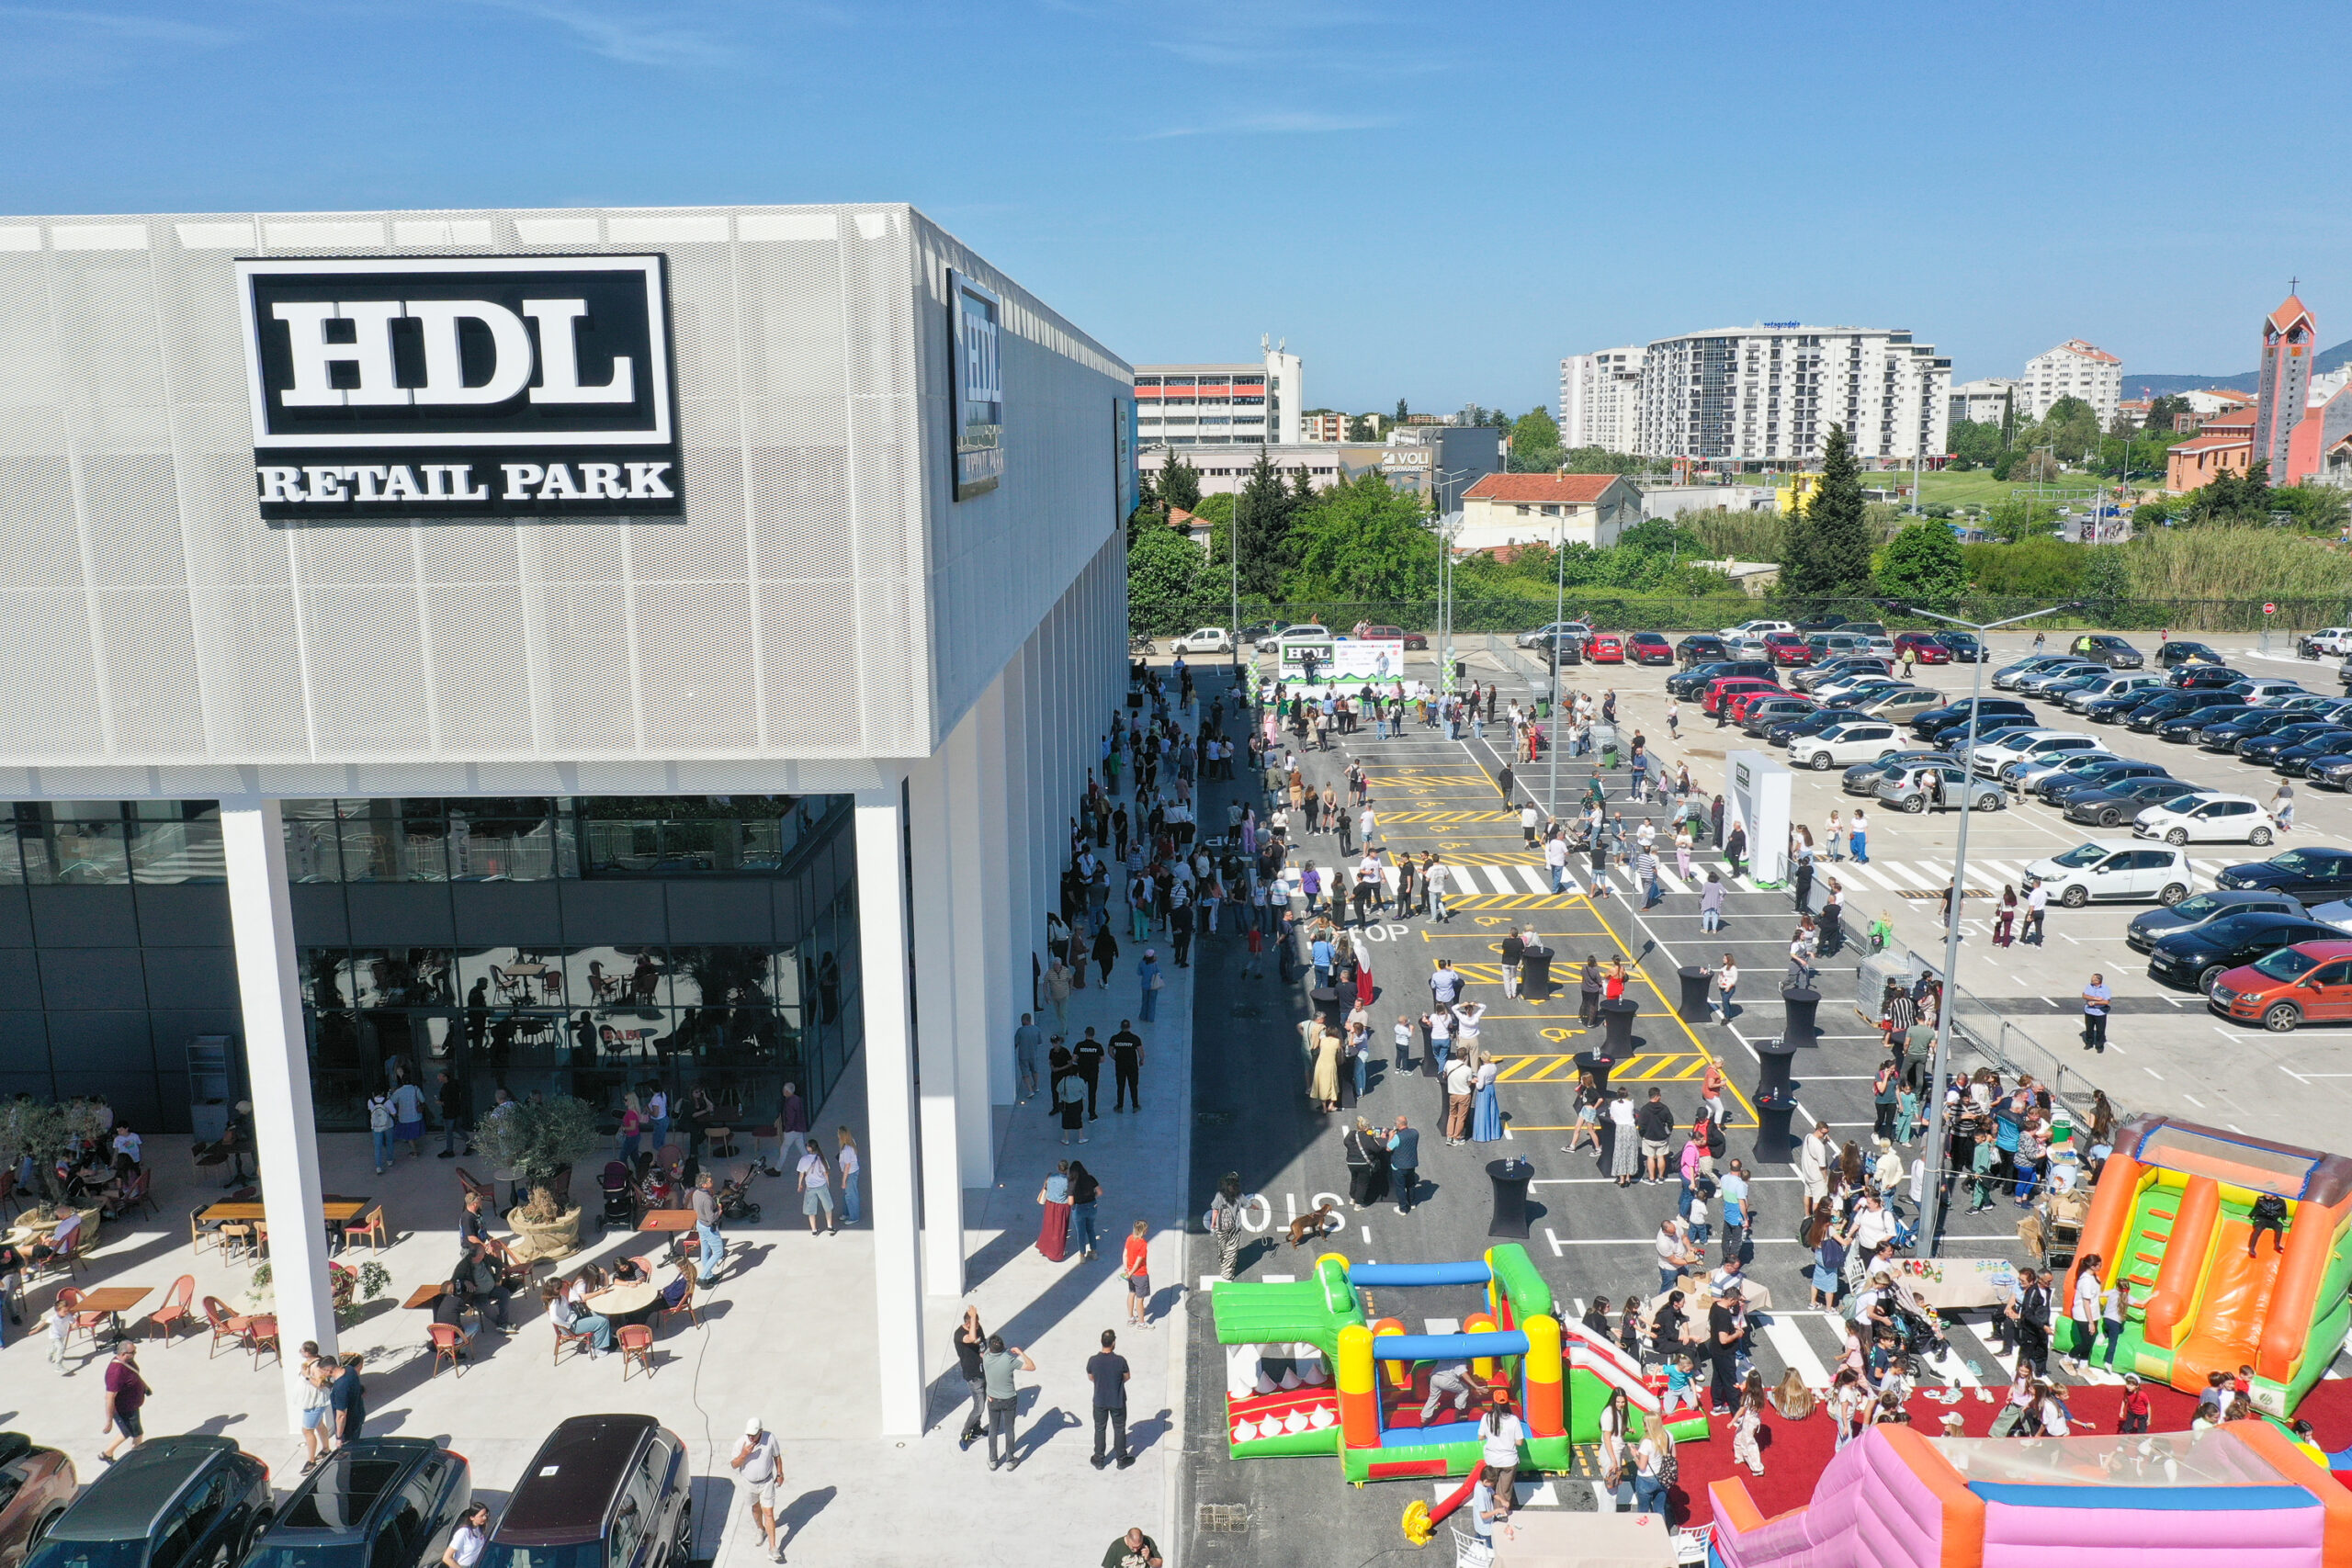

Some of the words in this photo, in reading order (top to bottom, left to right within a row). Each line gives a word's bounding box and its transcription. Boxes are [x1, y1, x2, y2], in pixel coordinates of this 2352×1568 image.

[272, 299, 635, 406] HDL
[965, 312, 1002, 402] HDL
[257, 465, 489, 502] RETAIL
[502, 462, 674, 500] PARK
[1398, 452, 1429, 465] VOLI
